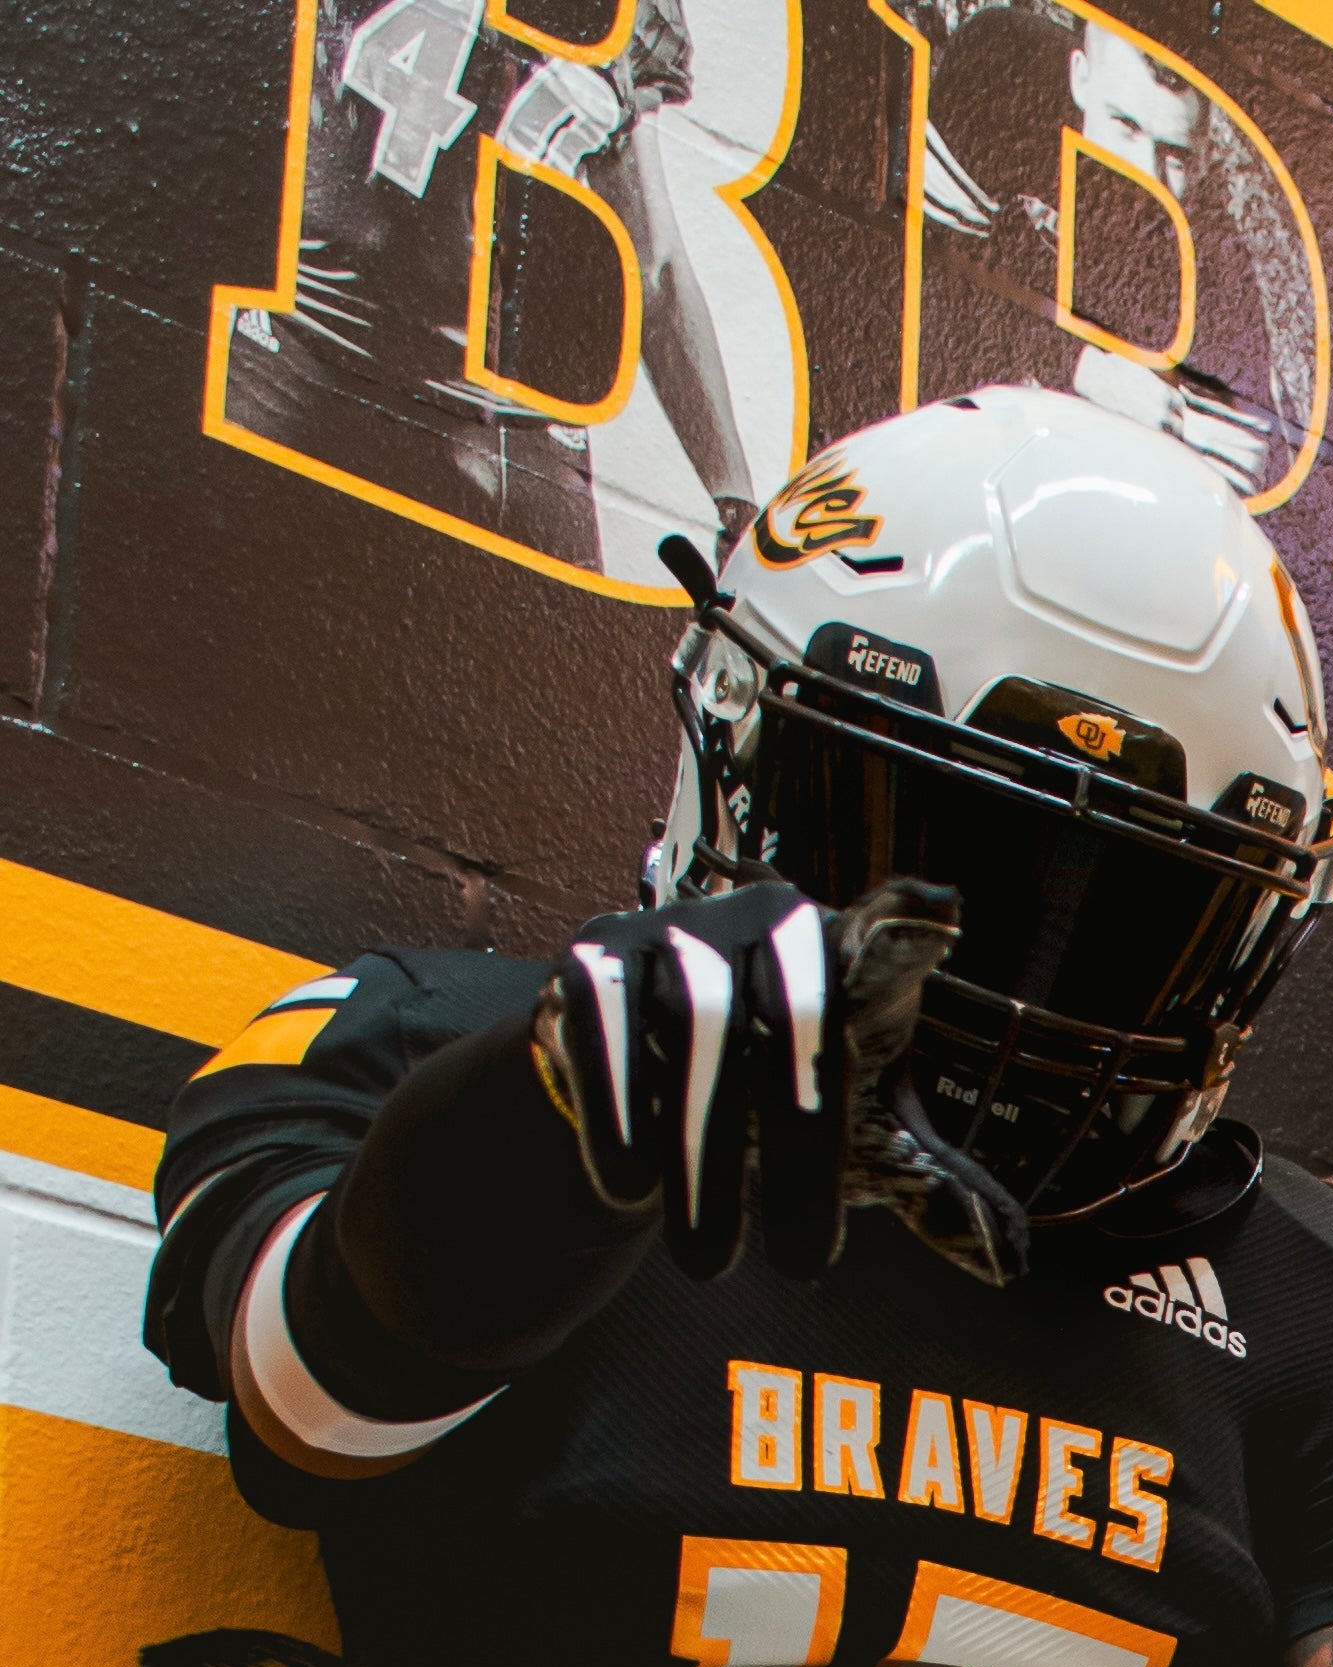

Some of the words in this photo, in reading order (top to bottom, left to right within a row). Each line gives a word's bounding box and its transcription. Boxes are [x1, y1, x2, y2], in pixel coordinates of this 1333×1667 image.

[848, 634, 922, 687] REFEND
[1076, 718, 1105, 752] OU
[936, 1075, 1020, 1124] Ridell
[1104, 1281, 1247, 1358] adidas
[728, 1360, 1174, 1572] BRAVES
